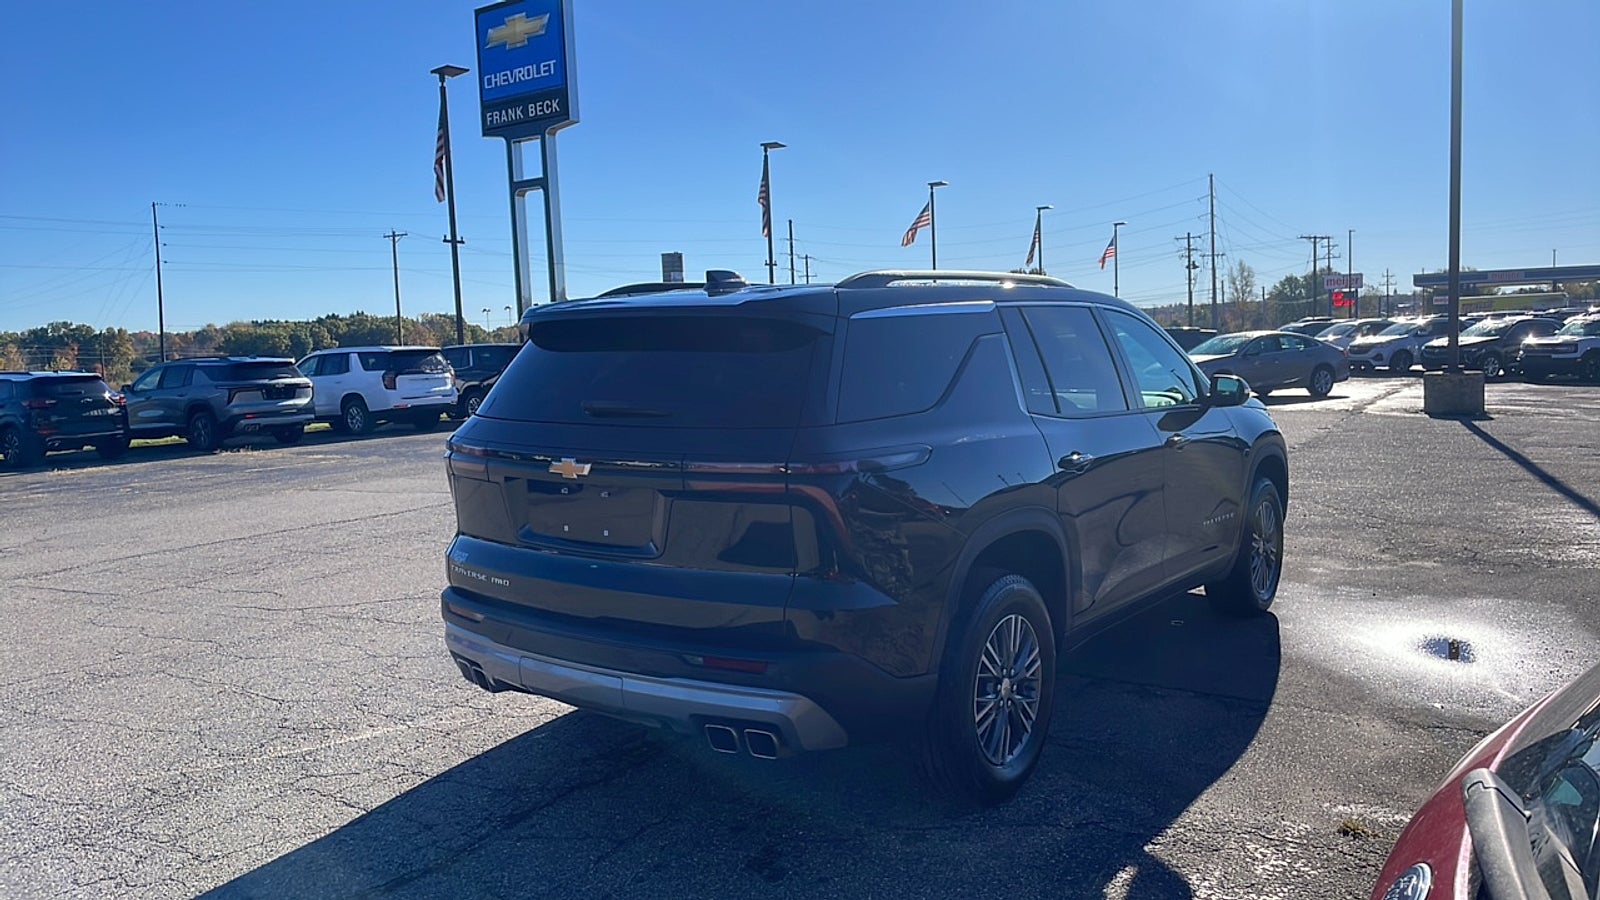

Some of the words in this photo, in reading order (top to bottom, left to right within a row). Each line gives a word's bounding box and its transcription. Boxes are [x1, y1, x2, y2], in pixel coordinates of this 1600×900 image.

[484, 60, 557, 89] CHEVROLET
[486, 106, 524, 126] FRANK
[528, 98, 560, 117] BECK
[1326, 276, 1360, 287] meijer
